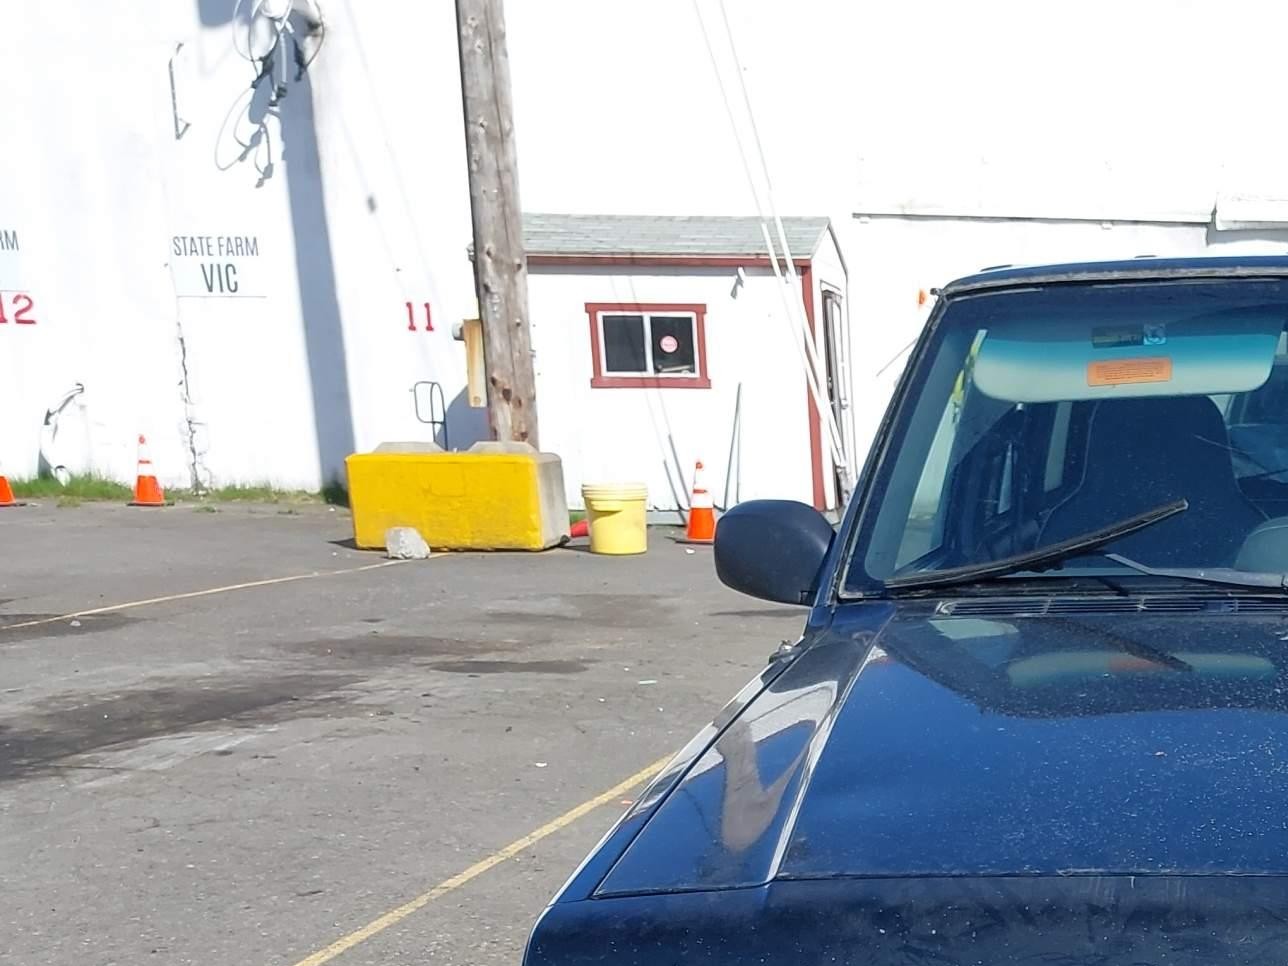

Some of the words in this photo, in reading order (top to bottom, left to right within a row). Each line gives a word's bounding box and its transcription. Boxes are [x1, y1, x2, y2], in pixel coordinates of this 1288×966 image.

[172, 236, 214, 256] STATE
[217, 236, 259, 256] FARM
[200, 263, 238, 293] VIC
[405, 301, 434, 331] 11
